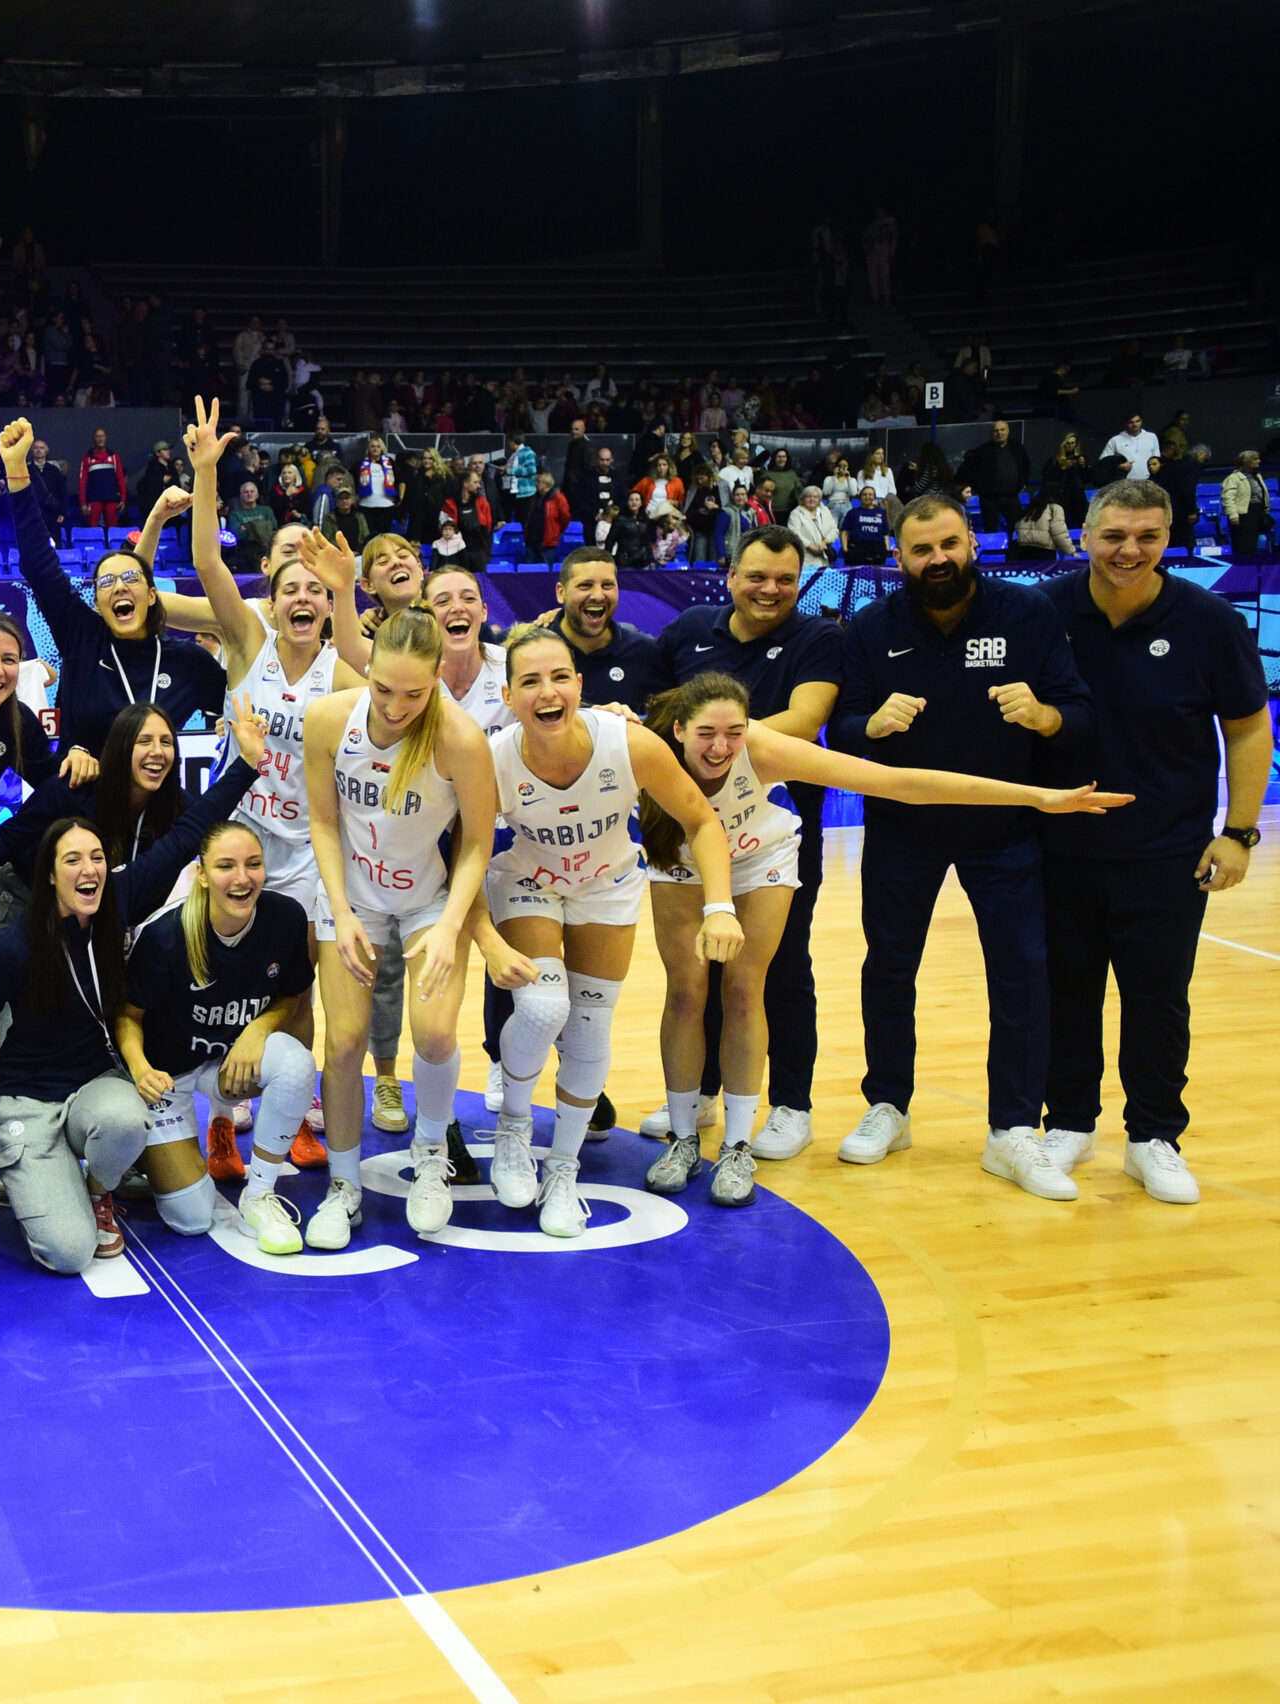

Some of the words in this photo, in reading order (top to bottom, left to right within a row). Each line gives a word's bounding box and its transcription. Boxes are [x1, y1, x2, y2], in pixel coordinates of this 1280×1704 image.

[930, 387, 939, 400] B
[965, 637, 1007, 660] SRB
[965, 659, 1006, 668] BASKETBALL
[42, 711, 56, 736] 5
[257, 748, 292, 781] 24
[239, 789, 300, 820] mts
[369, 821, 378, 850] 1
[520, 812, 620, 846] SRBIJA
